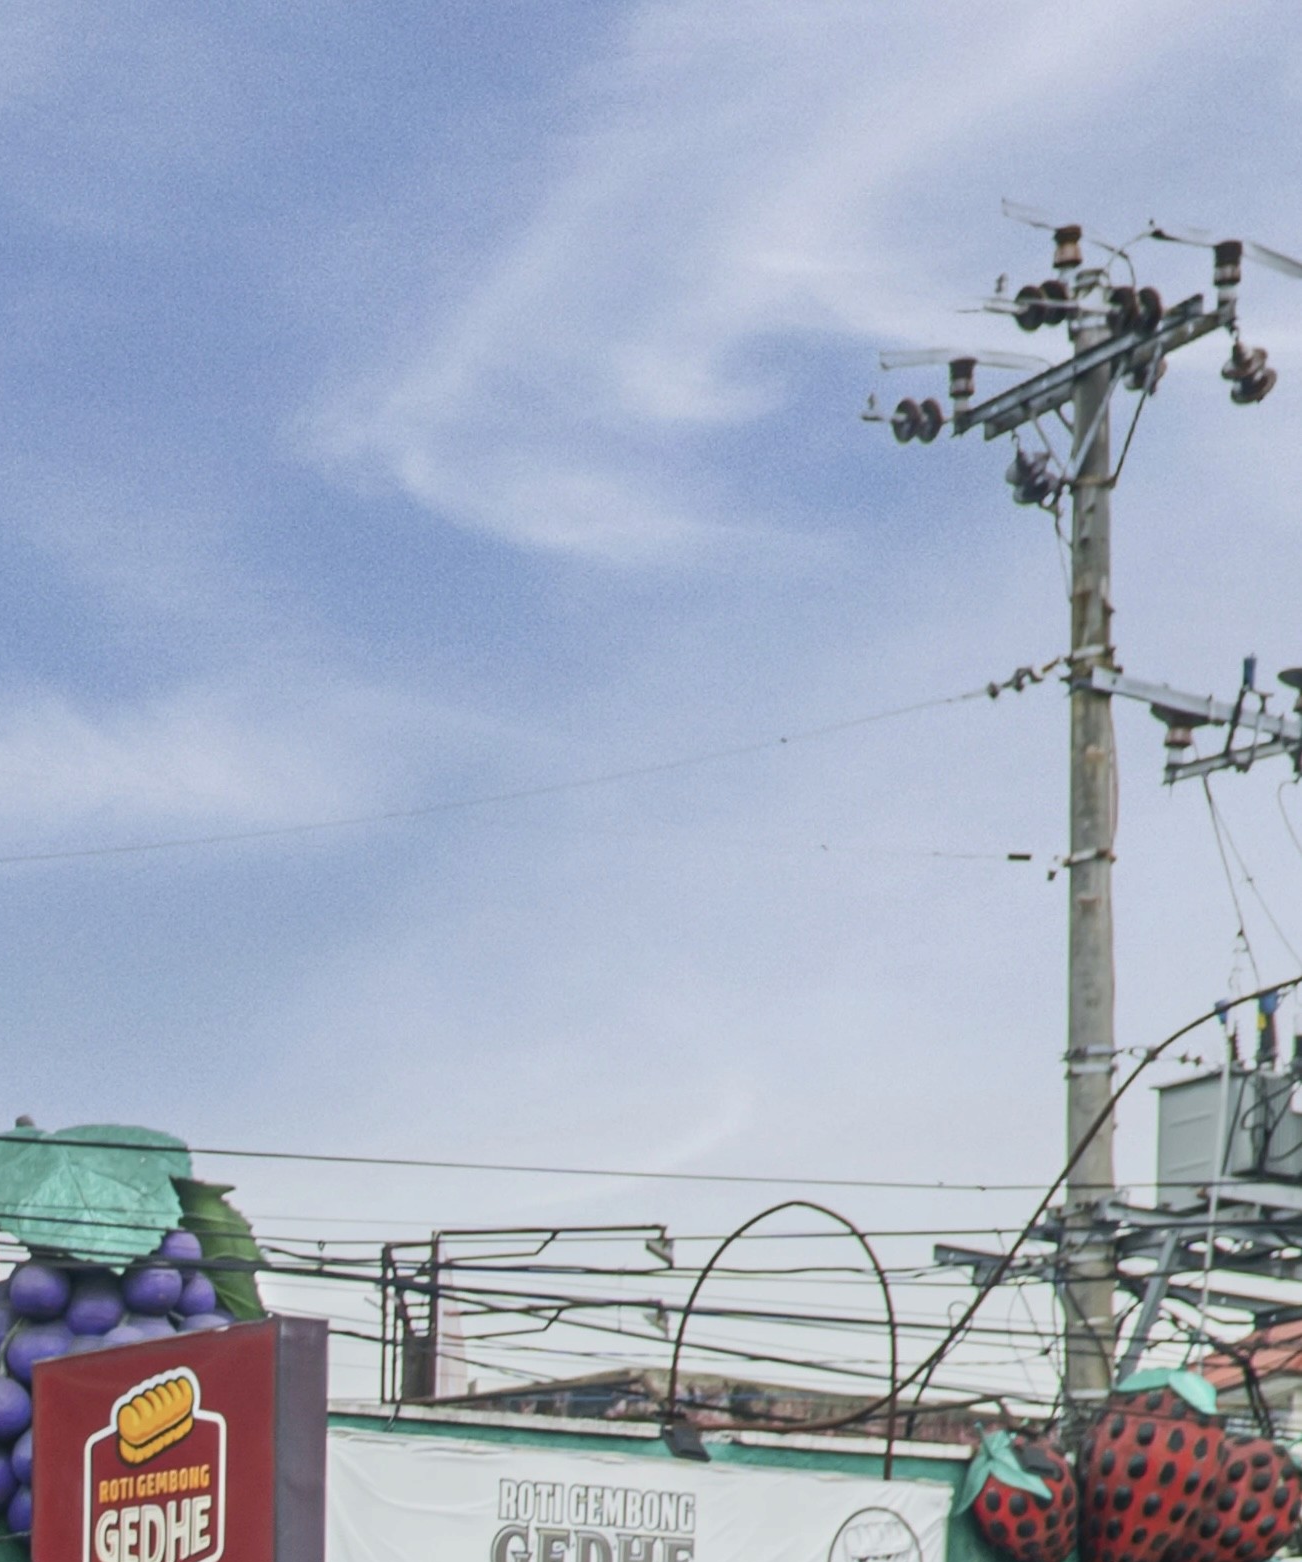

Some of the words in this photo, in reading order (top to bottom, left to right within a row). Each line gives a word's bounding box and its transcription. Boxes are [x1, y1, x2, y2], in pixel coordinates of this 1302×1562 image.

[99, 1477, 134, 1504] ROTI
[136, 1464, 211, 1497] GEMBONG
[498, 1479, 564, 1524] ROTI
[567, 1484, 696, 1534] GEMBONG
